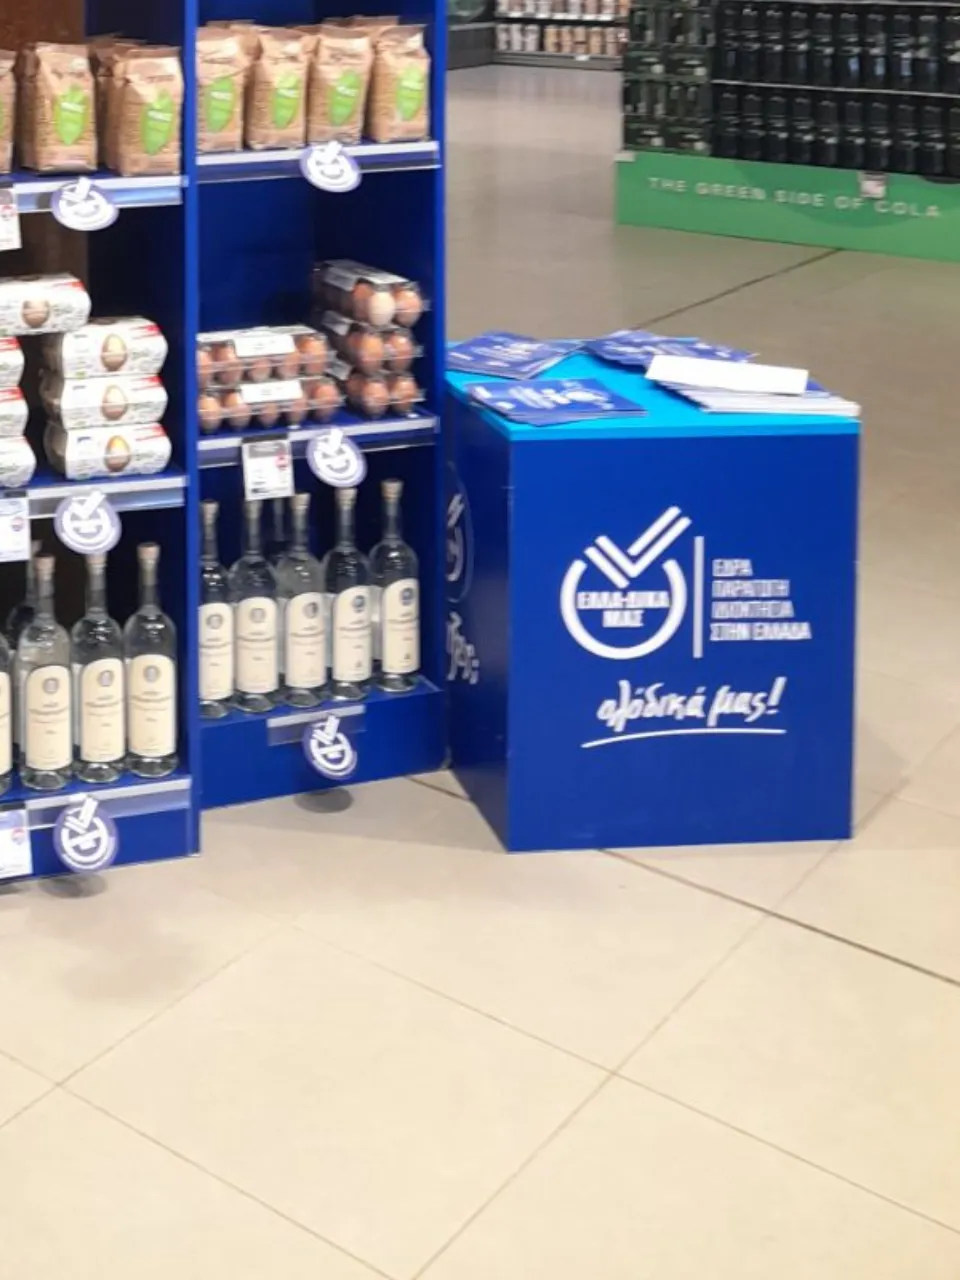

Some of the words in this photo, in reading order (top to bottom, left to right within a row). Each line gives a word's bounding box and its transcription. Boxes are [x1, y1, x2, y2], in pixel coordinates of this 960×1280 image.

[648, 176, 687, 192] THE
[695, 182, 766, 200] GREEN
[774, 189, 825, 207] SIDE
[834, 195, 864, 210] OF
[874, 199, 940, 218] COLA
